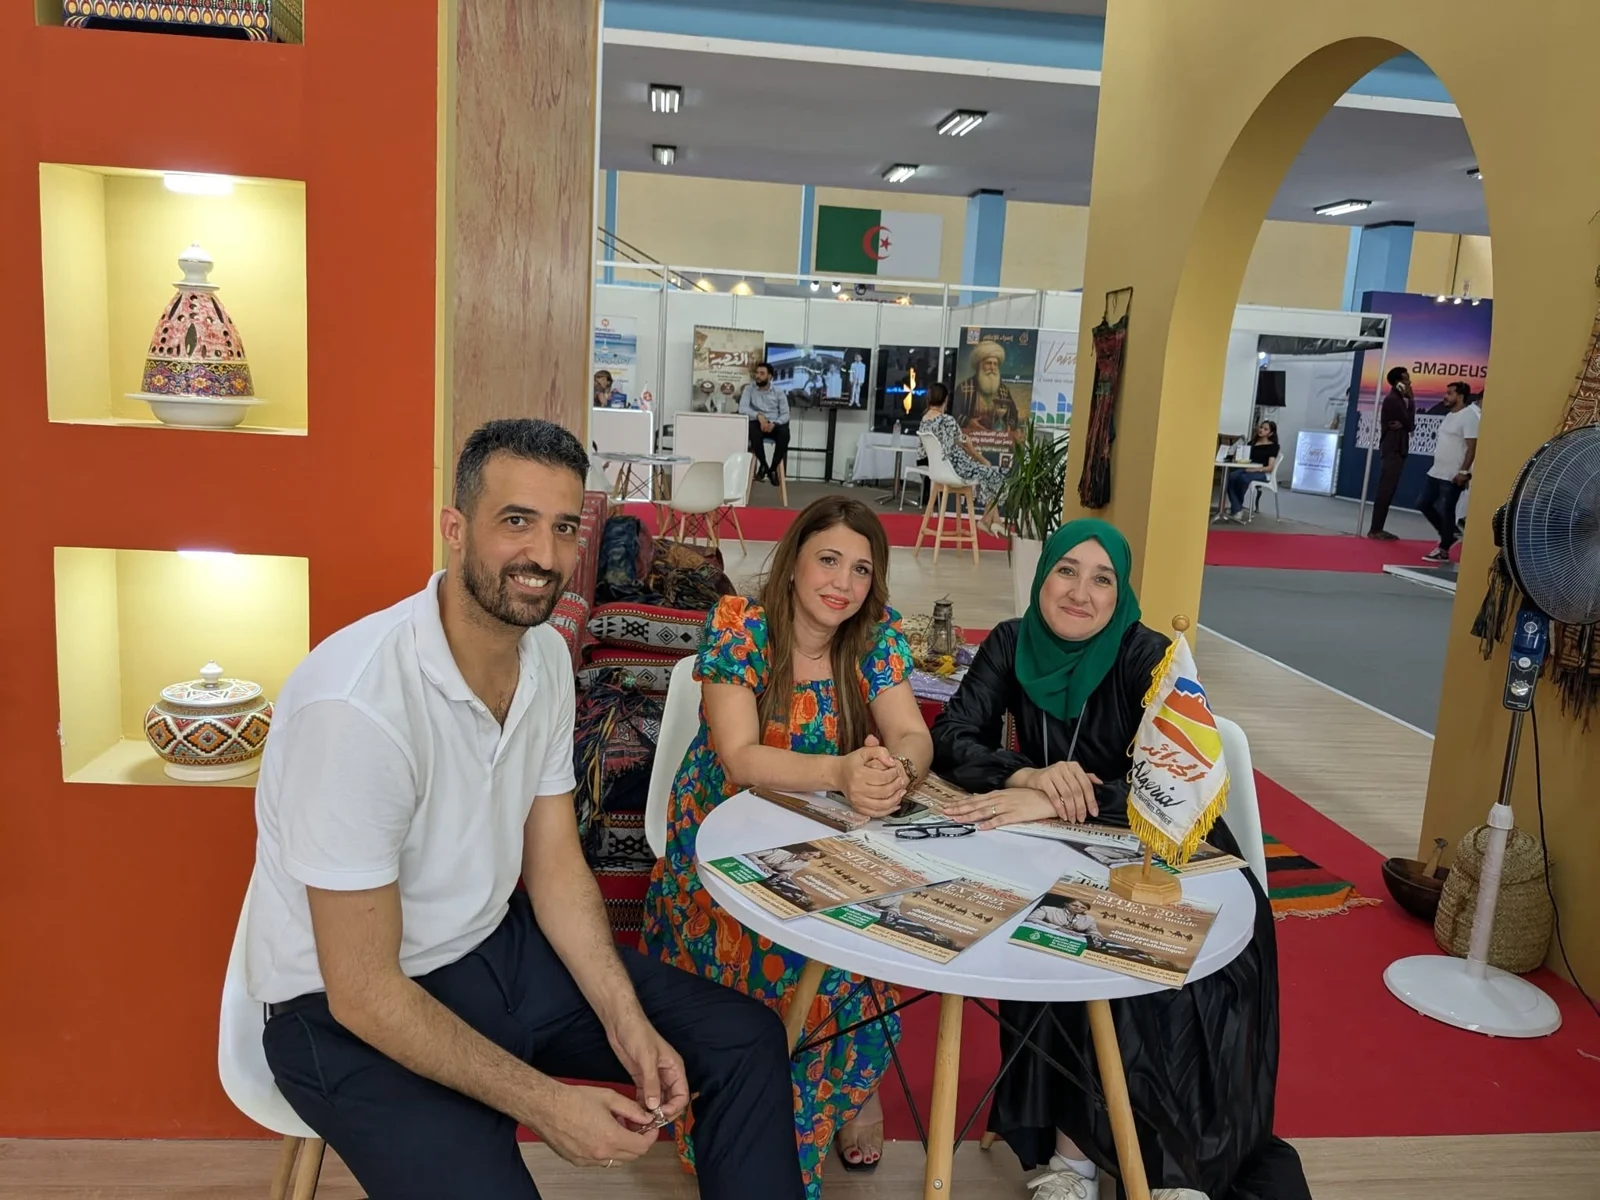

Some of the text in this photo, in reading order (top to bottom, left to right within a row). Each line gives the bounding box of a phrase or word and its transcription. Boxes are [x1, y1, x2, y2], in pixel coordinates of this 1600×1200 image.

[1133, 760, 1186, 808] Algeria
[1136, 791, 1172, 825] Tourism Office
[1092, 899, 1116, 911] pour
[1164, 915, 1198, 928] monde
[1095, 893, 1151, 912] SITEV
[1157, 908, 1192, 922] 2025
